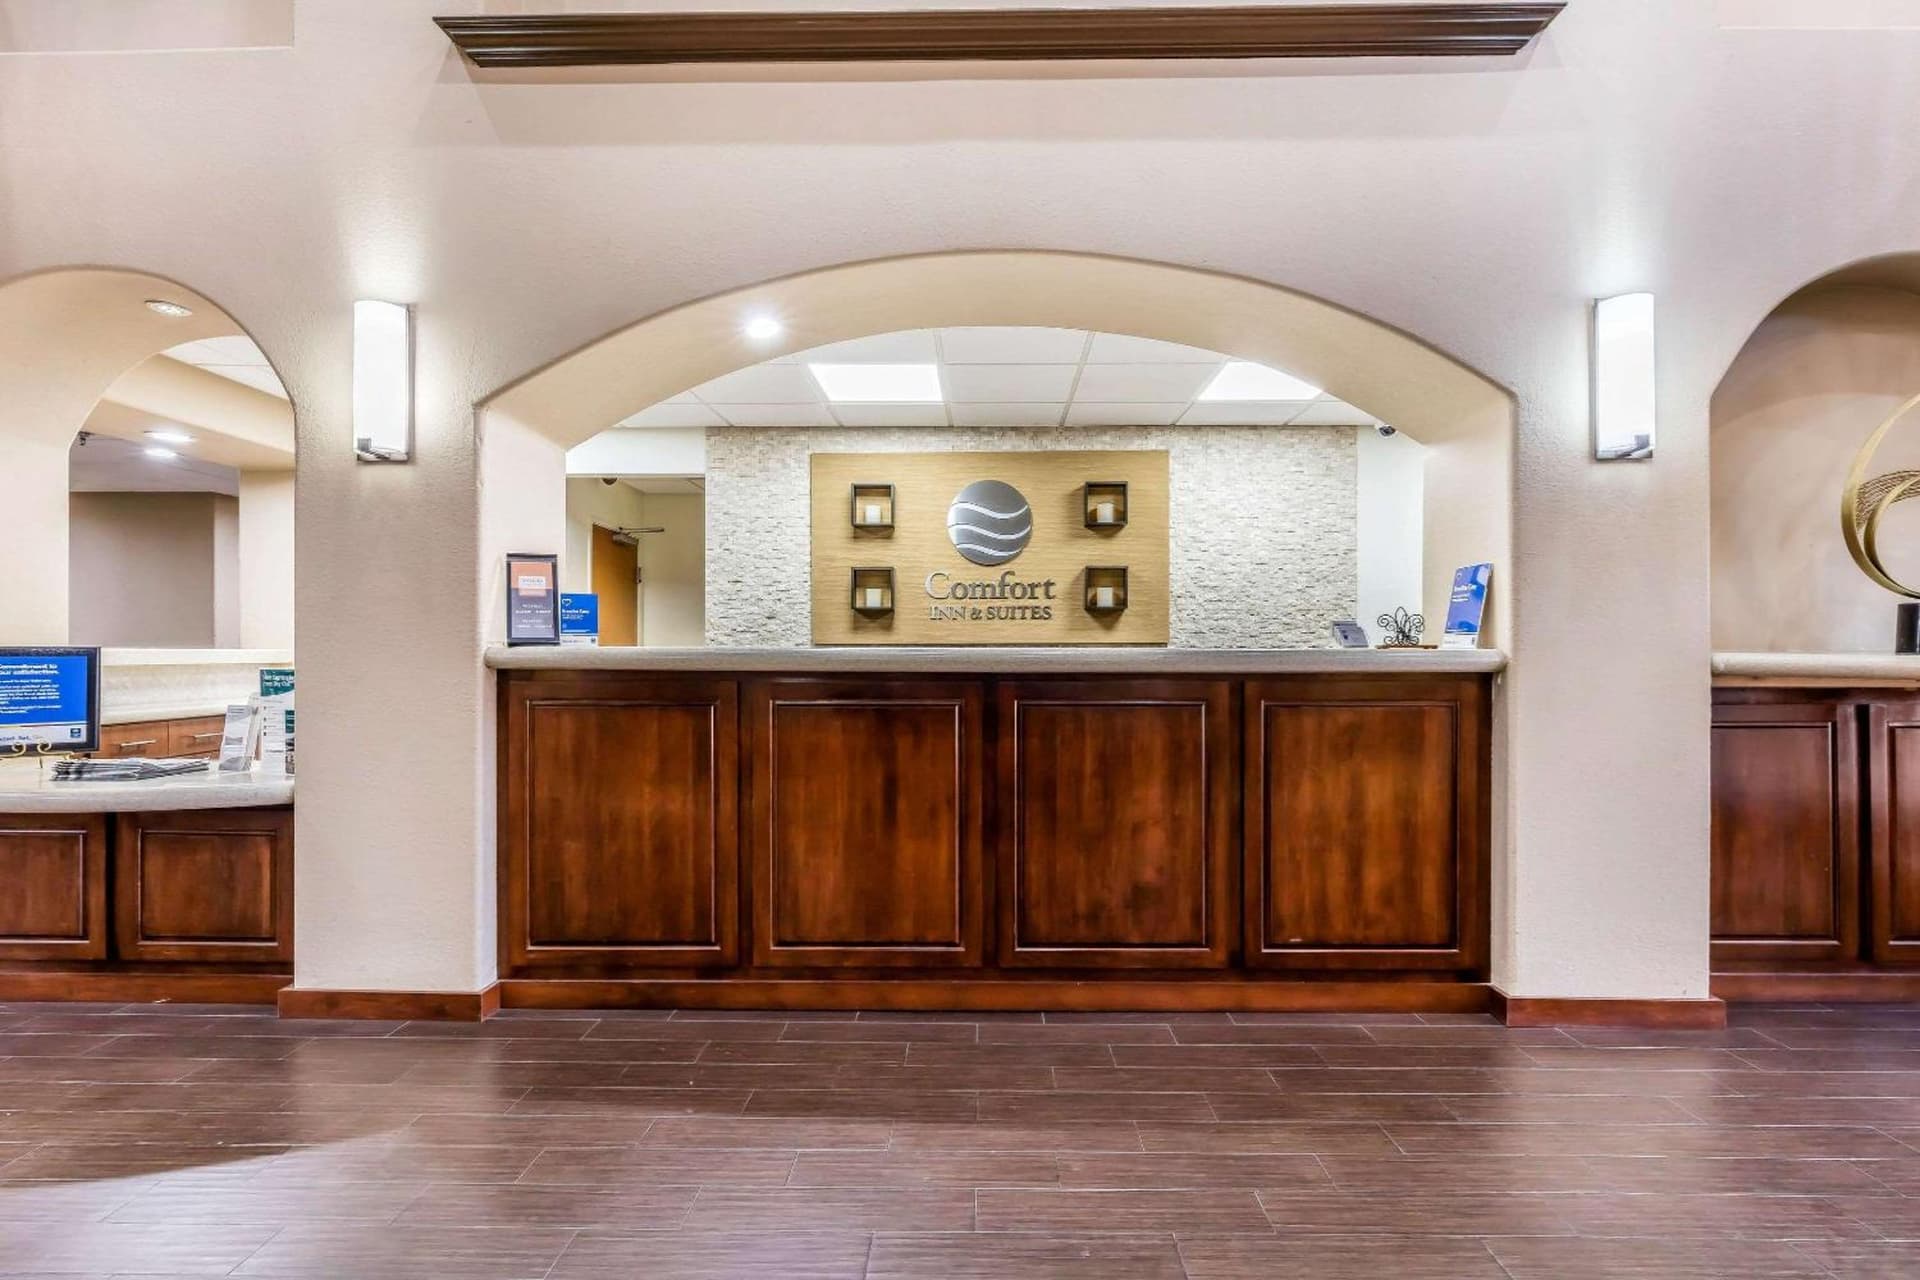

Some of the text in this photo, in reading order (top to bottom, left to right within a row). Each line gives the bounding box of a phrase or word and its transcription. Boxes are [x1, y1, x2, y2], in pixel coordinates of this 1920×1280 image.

[925, 571, 1056, 600] Comfort
[928, 605, 1053, 620] INN & SUITES
